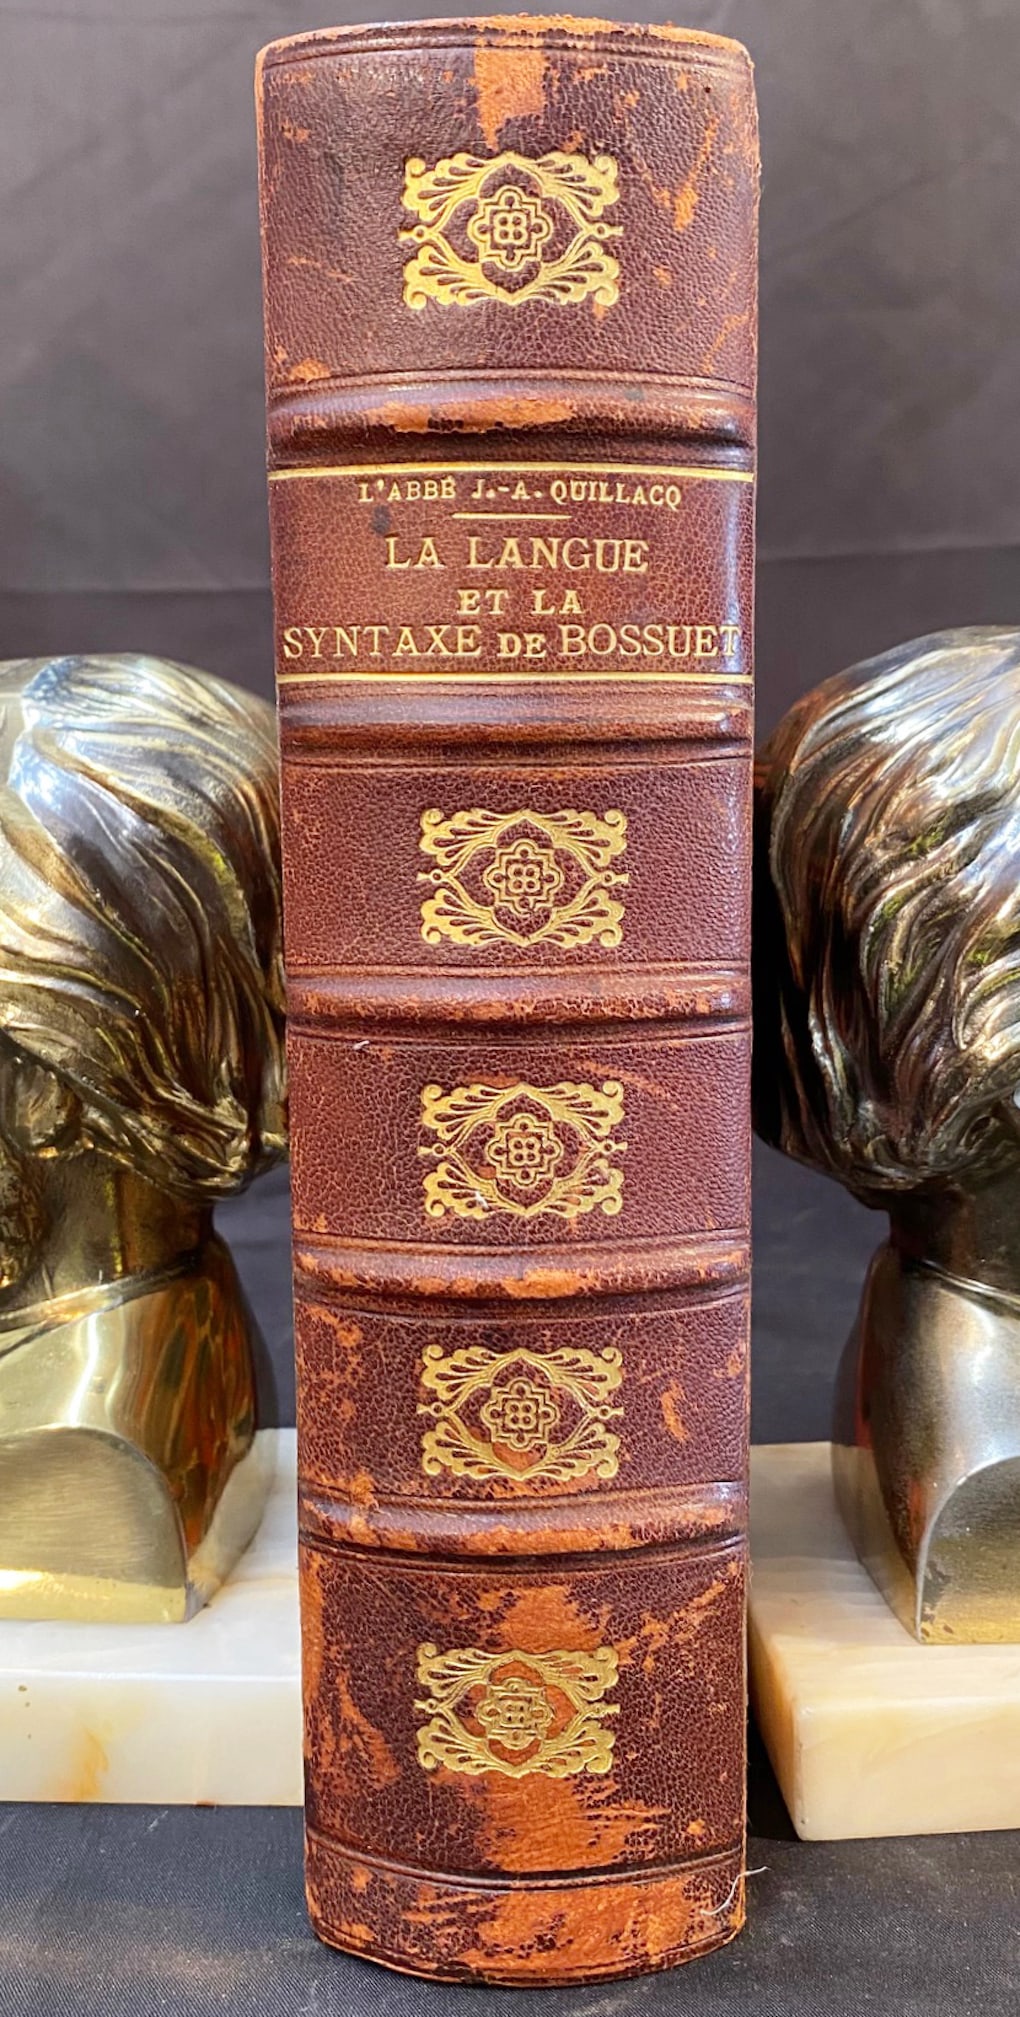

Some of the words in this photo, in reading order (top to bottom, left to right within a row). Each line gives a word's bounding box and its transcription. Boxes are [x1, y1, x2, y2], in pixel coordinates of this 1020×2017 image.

[550, 479, 682, 511] QUILLACQ
[385, 536, 446, 569] LA
[466, 536, 650, 573] LANGUE
[457, 589, 509, 615] ET
[531, 589, 584, 615] LA
[283, 624, 482, 659] SYNTAXE
[497, 632, 547, 659] DE
[558, 623, 742, 658] BOSSUET
